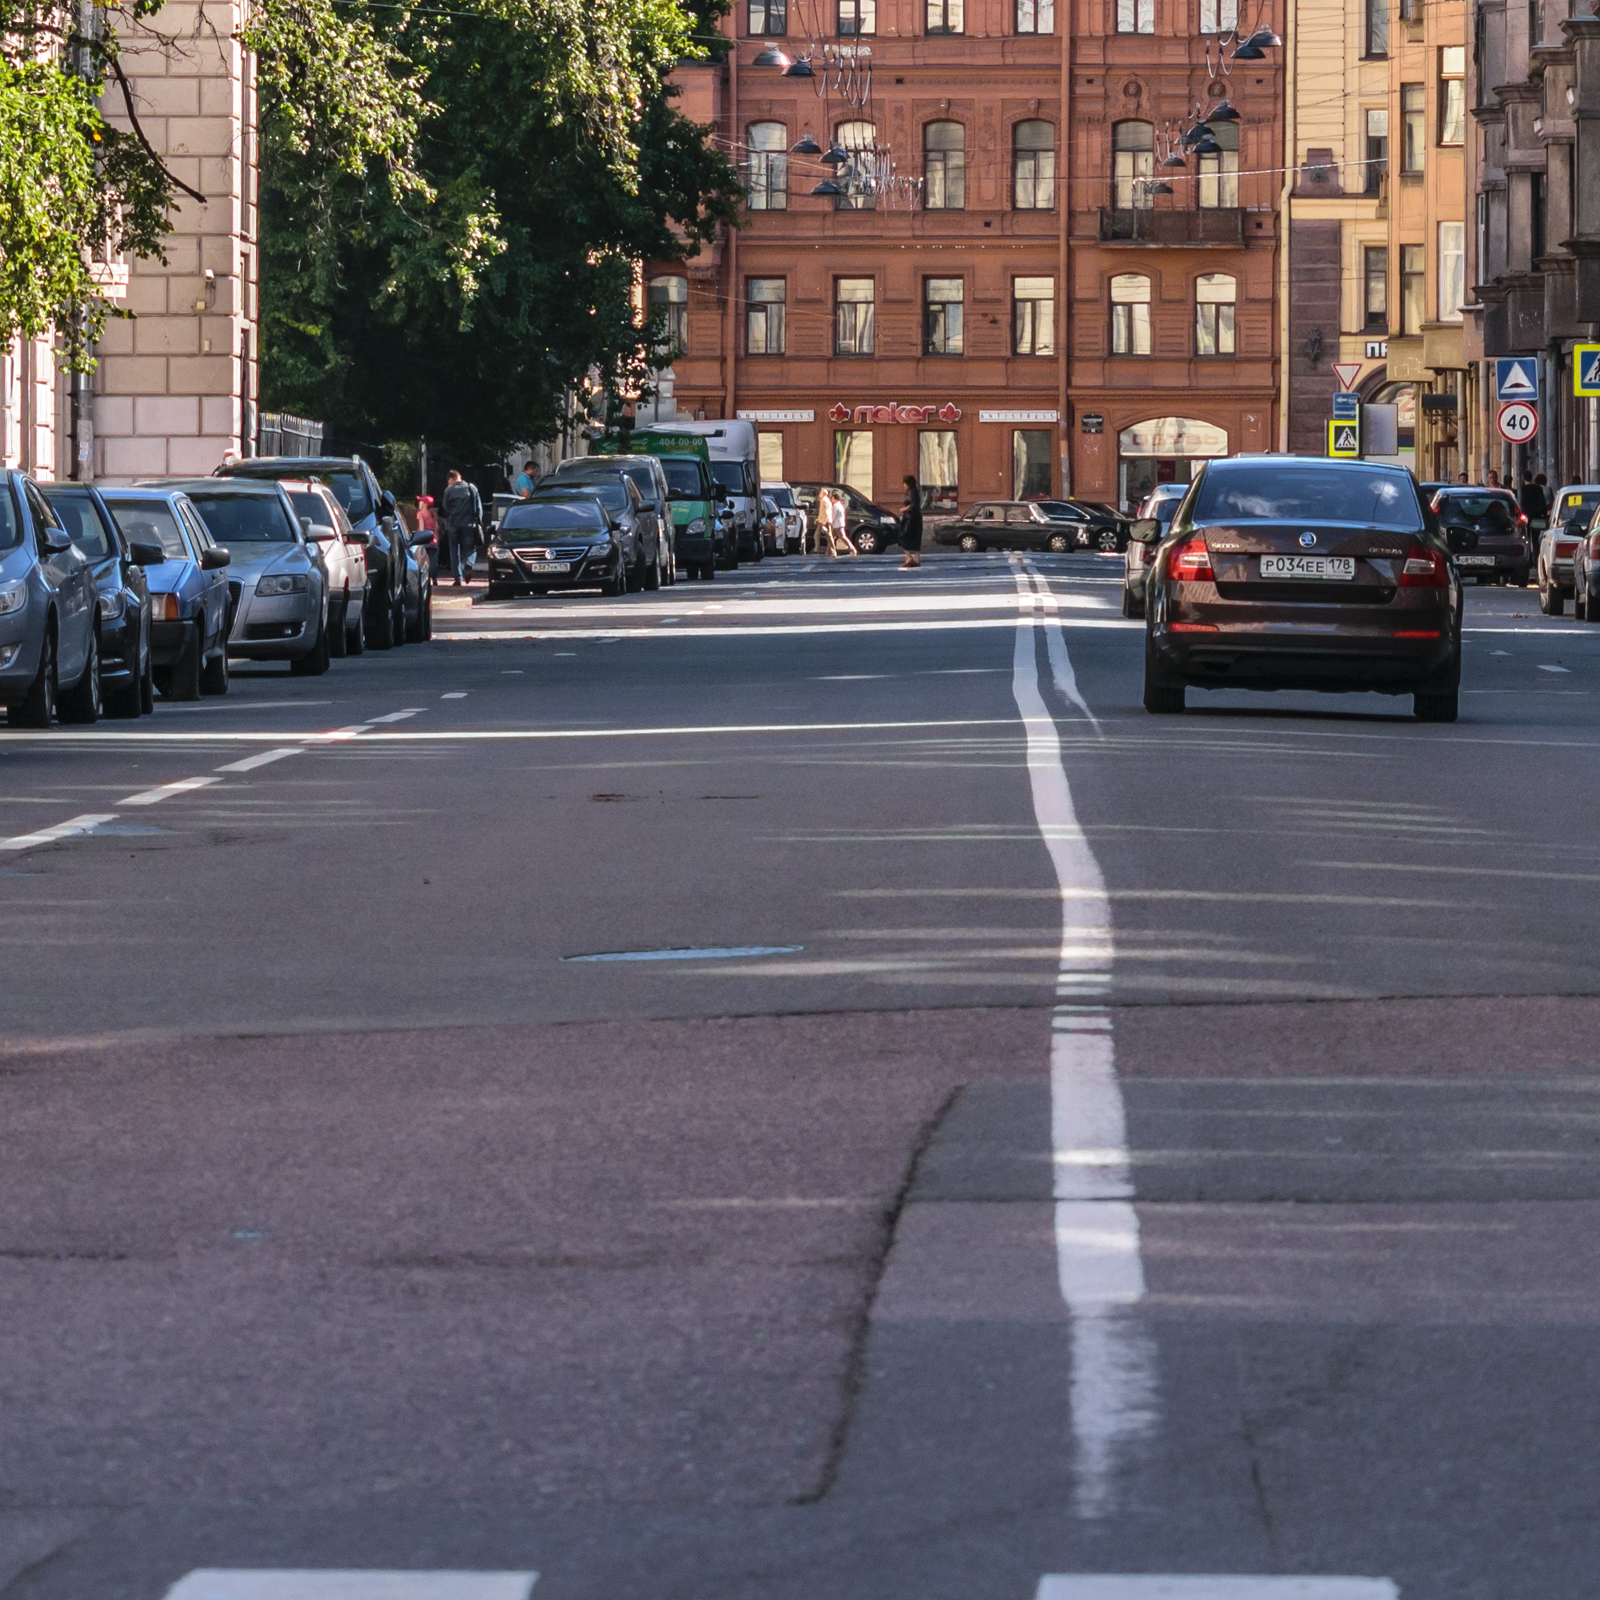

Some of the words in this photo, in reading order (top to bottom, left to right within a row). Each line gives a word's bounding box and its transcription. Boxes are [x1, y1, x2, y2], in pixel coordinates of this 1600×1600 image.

[1506, 413, 1530, 431] 40
[659, 437, 703, 447] 404-00-00
[1328, 558, 1351, 570] 178
